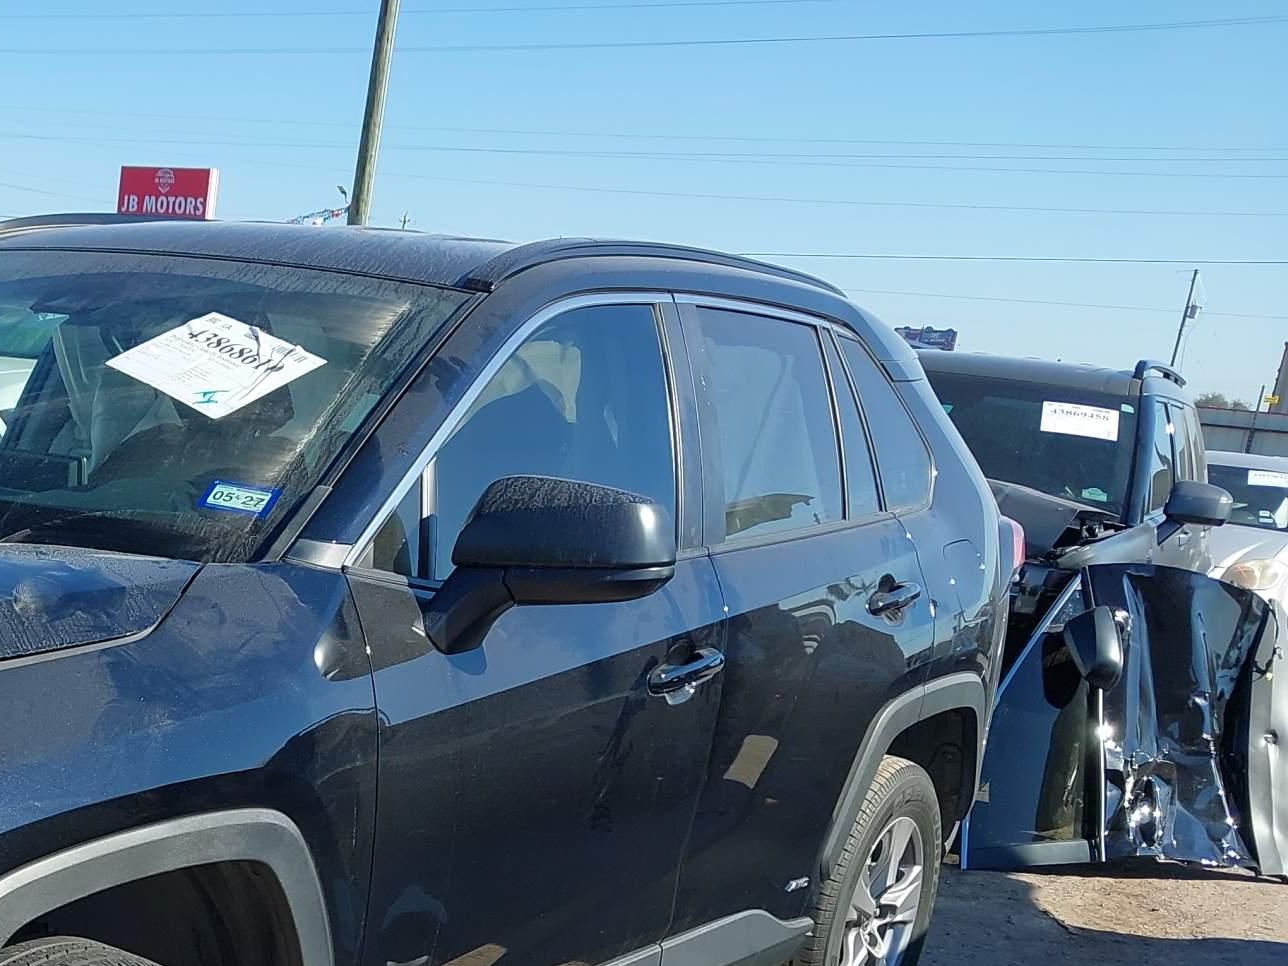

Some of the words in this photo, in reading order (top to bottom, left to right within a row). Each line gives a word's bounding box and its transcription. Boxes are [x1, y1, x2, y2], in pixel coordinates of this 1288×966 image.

[121, 195, 138, 213] JB
[142, 195, 204, 216] MOTORS
[212, 490, 235, 503] 05
